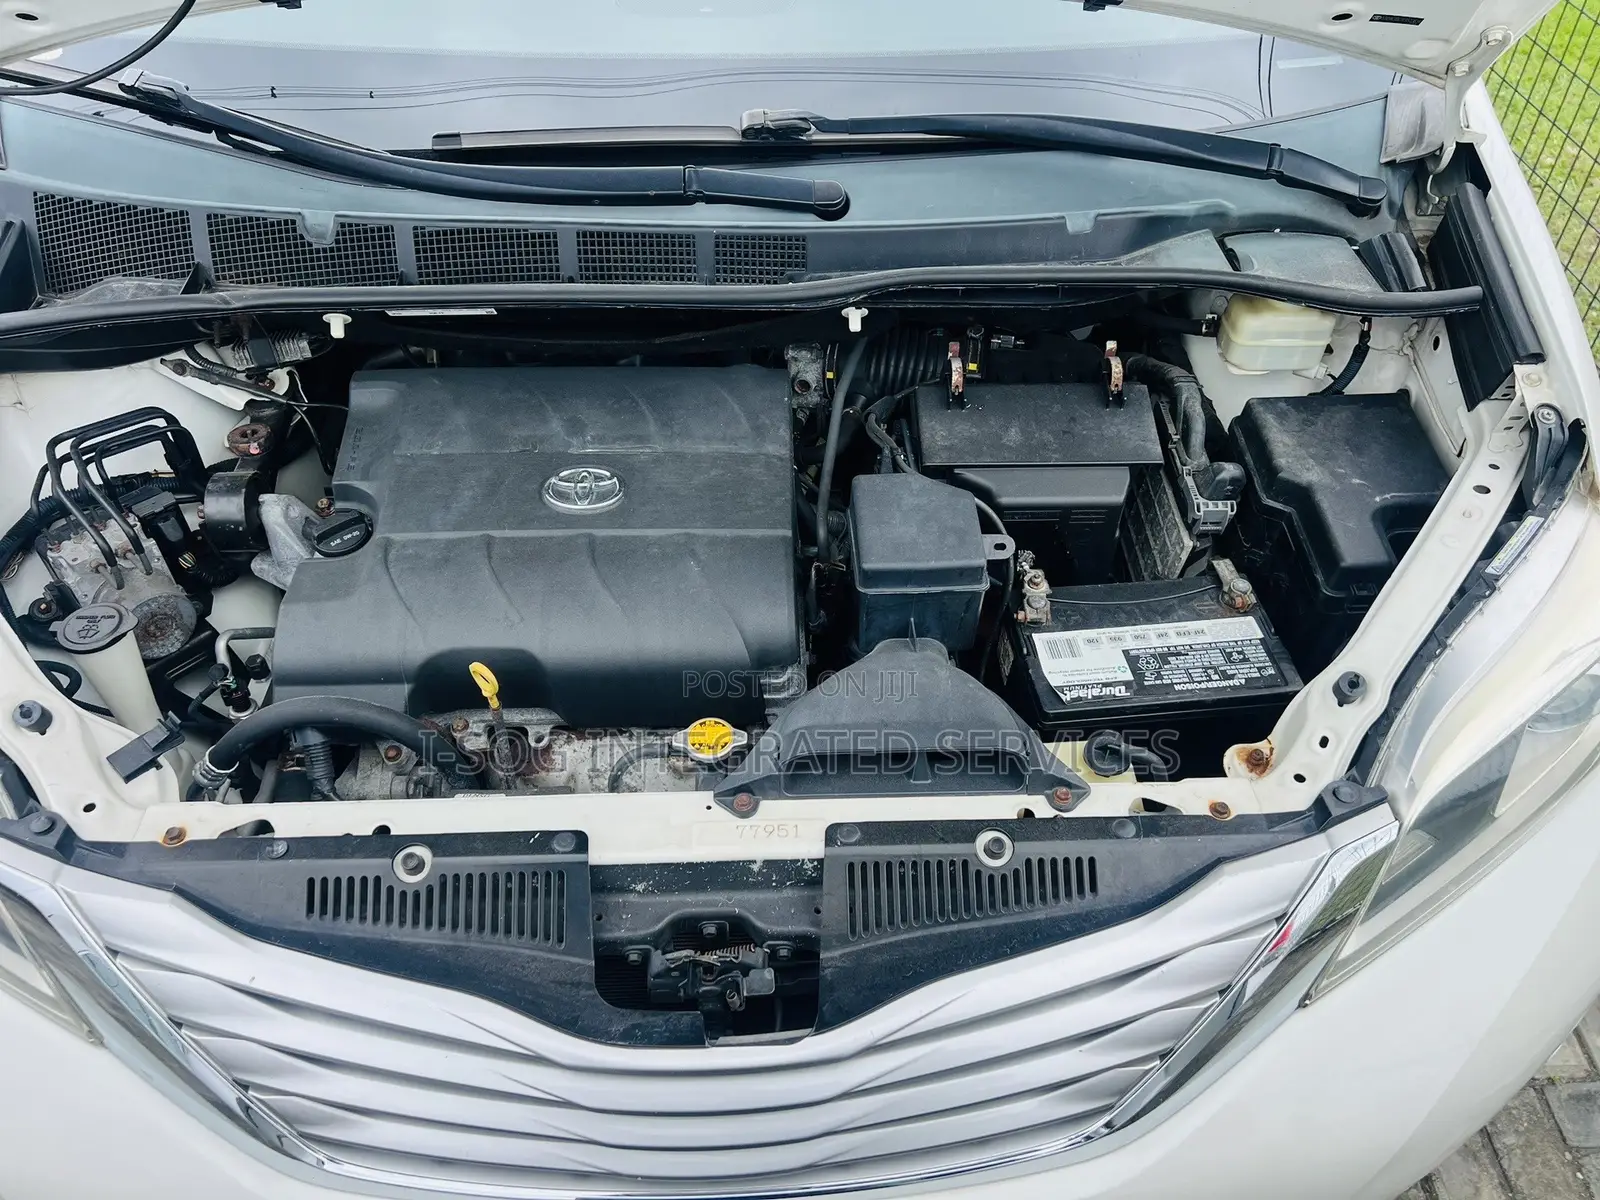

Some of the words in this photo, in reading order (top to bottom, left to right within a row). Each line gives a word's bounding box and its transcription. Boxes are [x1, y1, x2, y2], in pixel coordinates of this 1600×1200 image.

[330, 538, 342, 547] SAE
[1062, 685, 1130, 702] Duralast
[736, 824, 801, 840] 77951
